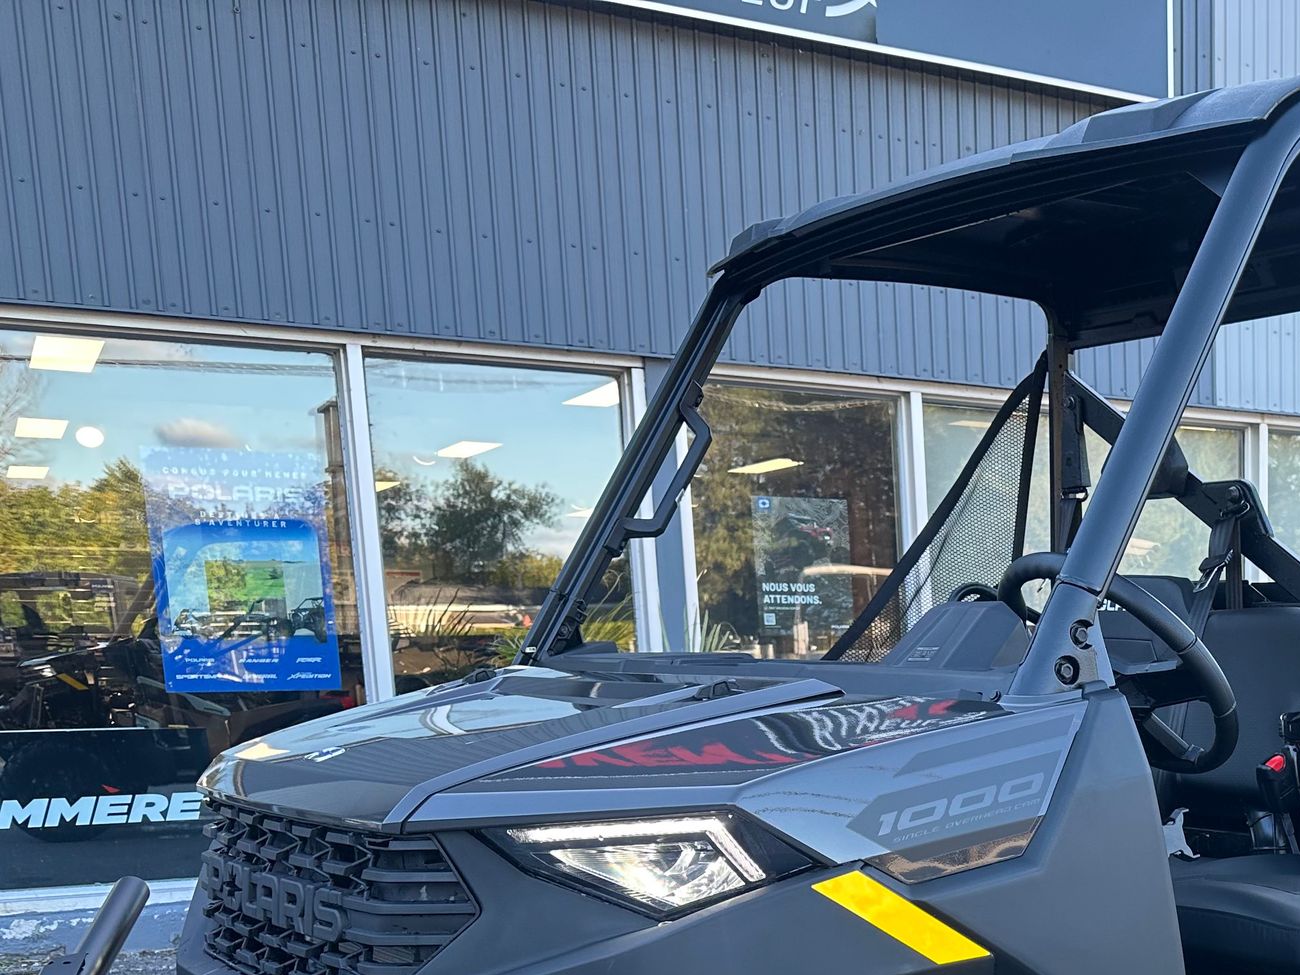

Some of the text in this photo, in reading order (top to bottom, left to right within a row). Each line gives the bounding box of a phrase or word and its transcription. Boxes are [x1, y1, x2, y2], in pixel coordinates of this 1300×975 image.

[168, 482, 302, 502] POLARIS
[194, 518, 287, 528] S'AVENTURER
[762, 582, 816, 593] NOUS VOUS
[763, 594, 823, 605] ATTENDONS.
[878, 772, 1045, 837] 1000
[893, 826, 941, 842] SINGLE
[201, 850, 347, 943] POLARIS
